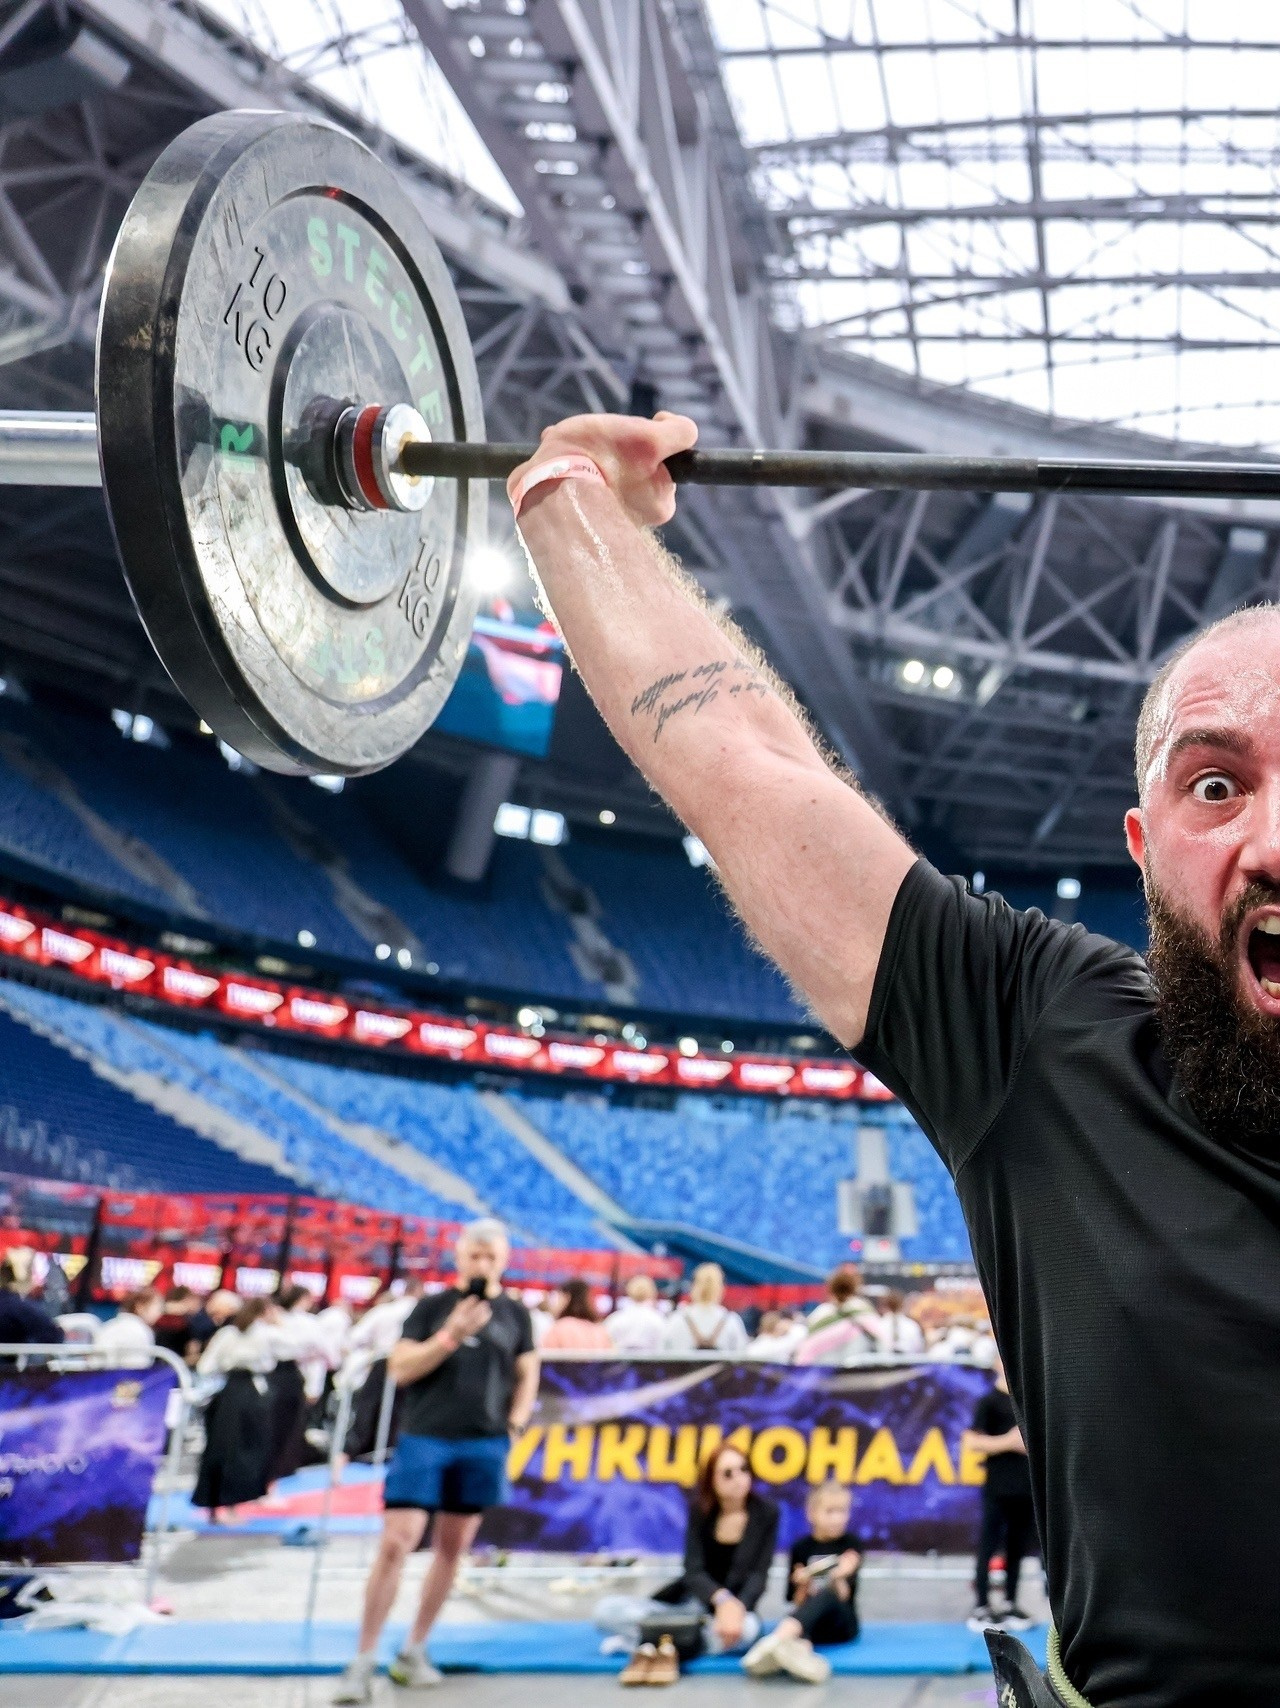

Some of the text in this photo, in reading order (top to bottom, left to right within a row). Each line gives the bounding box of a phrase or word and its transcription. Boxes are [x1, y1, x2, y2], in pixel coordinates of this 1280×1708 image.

[249, 246, 287, 321] 10
[223, 282, 272, 373] KG
[307, 217, 446, 480] STECTE
[415, 537, 441, 595] 10
[398, 570, 430, 640] KG
